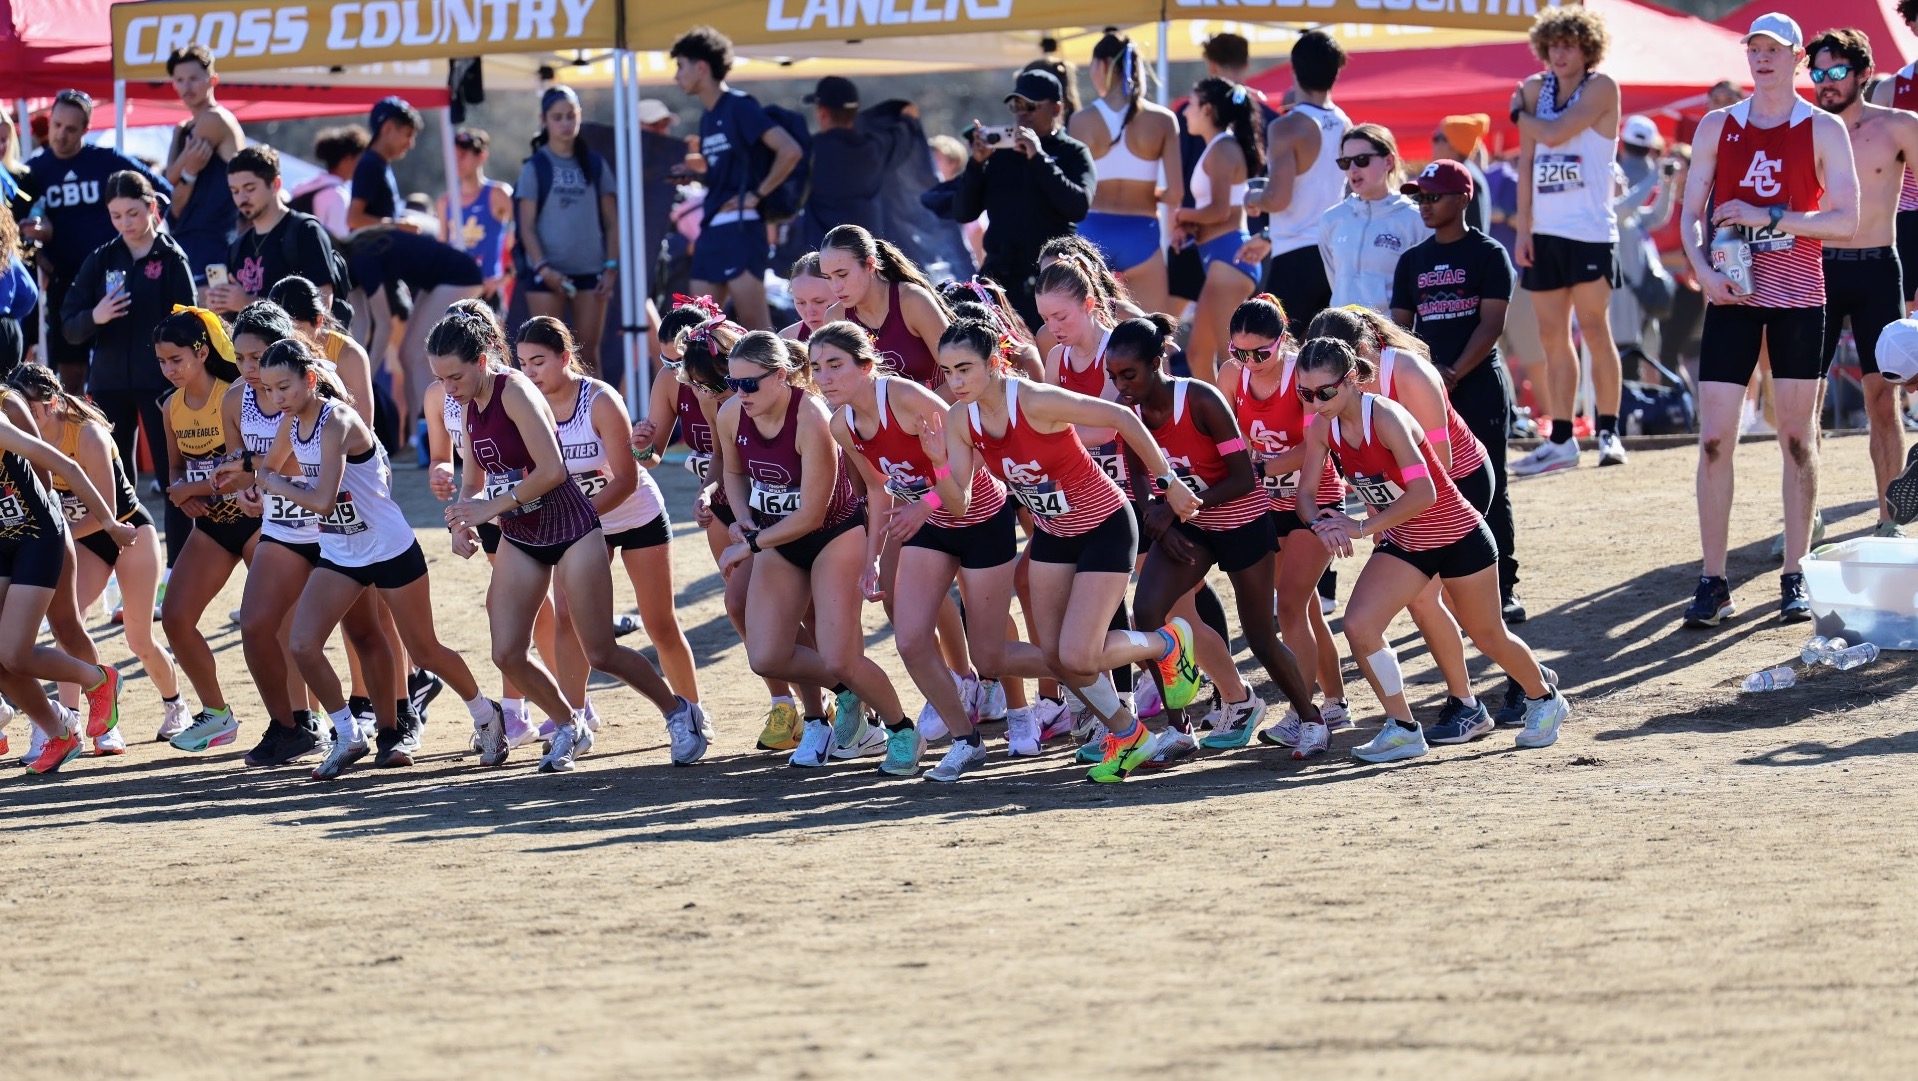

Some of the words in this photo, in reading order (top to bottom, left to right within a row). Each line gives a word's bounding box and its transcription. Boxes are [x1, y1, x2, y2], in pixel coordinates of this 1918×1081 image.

[123, 7, 308, 66] CROSS
[326, 0, 596, 50] COUNTRY
[1420, 163, 1439, 178] R
[1538, 164, 1578, 183] 3216
[1739, 150, 1782, 198] AC
[45, 180, 99, 208] CBU
[1417, 269, 1467, 288] SCIAC
[197, 427, 220, 438] EAGLES
[1250, 420, 1291, 453] AC
[879, 456, 924, 487] AC
[1002, 457, 1049, 485] AC
[757, 491, 800, 513] 164
[1356, 484, 1395, 503] 1131
